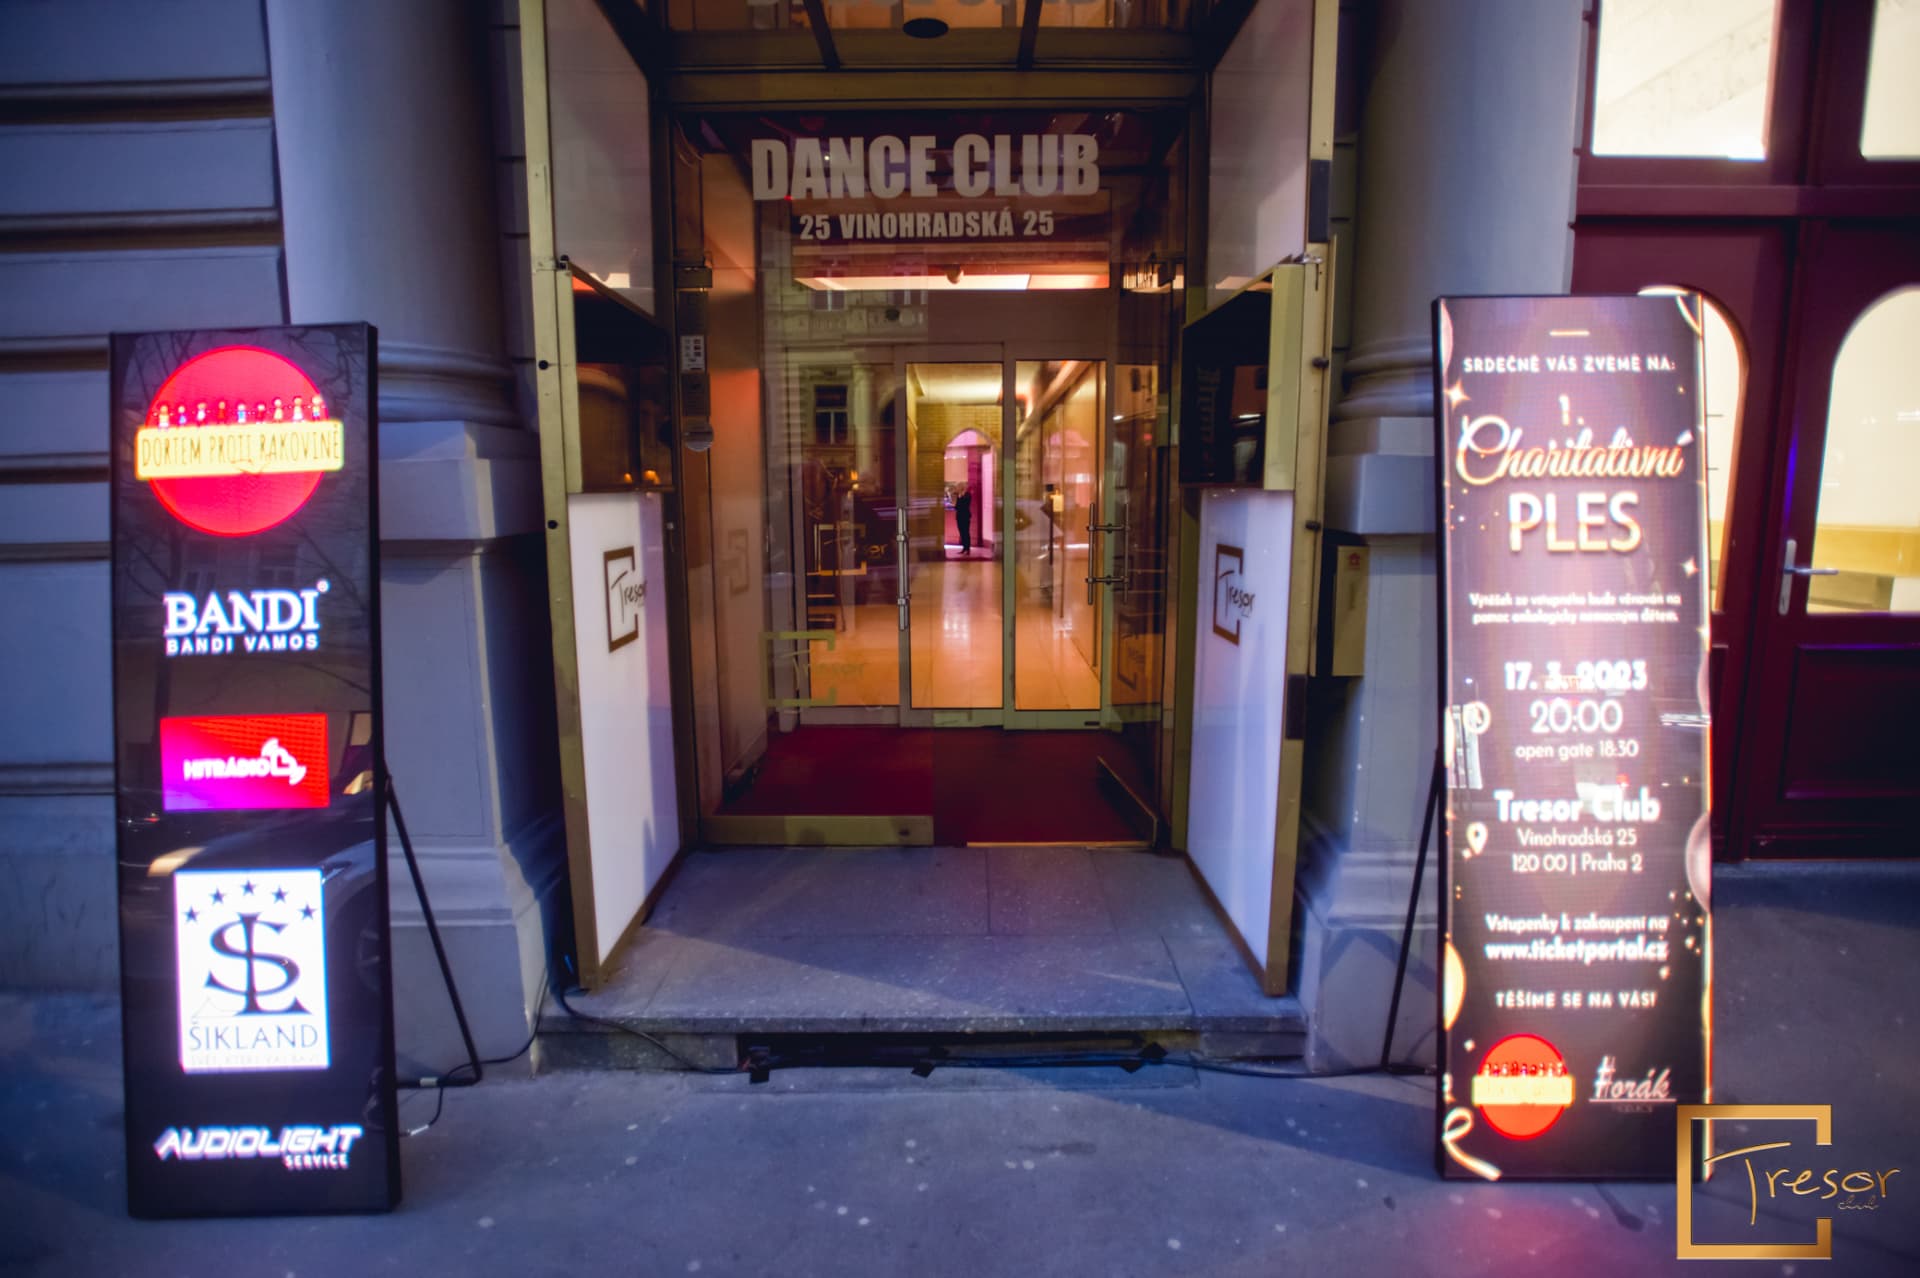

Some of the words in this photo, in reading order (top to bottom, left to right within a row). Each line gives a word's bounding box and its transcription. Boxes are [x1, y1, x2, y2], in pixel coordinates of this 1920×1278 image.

[751, 135, 937, 200] DANCE
[953, 133, 1100, 197] CLUB
[800, 214, 831, 240] 25
[840, 206, 1014, 239] VINOHRADSKÁ
[1023, 210, 1054, 236] 25
[1546, 354, 1578, 372] VÁS
[1584, 355, 1641, 372] ZVEME
[1647, 355, 1677, 371] NA:
[1559, 393, 1585, 427] 1.
[141, 438, 201, 467] DORTEM
[1455, 415, 1694, 486] Charitativní
[1508, 491, 1642, 553] PLES
[610, 570, 647, 624] Tresor
[1219, 570, 1255, 618] Tresor
[165, 636, 234, 656] BANDI
[244, 634, 320, 652] VAMOS
[1504, 661, 1538, 690] 17.
[1576, 659, 1648, 690] 2023
[1529, 700, 1623, 734] 20:00
[1515, 743, 1554, 761] open
[1558, 741, 1594, 762] gate
[1599, 739, 1639, 758] 18:30
[1493, 789, 1585, 823] Tresor
[1592, 787, 1661, 823] Club
[1516, 827, 1614, 847] Vinohradská
[1616, 827, 1637, 846] 25
[1512, 853, 1540, 873] 120
[1542, 853, 1568, 873] 00
[1581, 853, 1627, 873] Praha
[1630, 853, 1643, 872] 2
[1485, 912, 1557, 934] Vstupenky
[1560, 912, 1571, 931] k
[1573, 912, 1646, 934] zakoupení
[1648, 916, 1670, 931] na
[1484, 934, 1670, 966] www.ticketportal.cz
[1496, 989, 1556, 1009] TĚŠÍME
[1562, 991, 1582, 1008] SE
[1588, 991, 1613, 1008] NA
[1618, 989, 1658, 1007] VÁS!
[189, 1018, 319, 1051] ŠIKLAND
[153, 1125, 363, 1161] AUDIOLIGHT
[284, 1153, 349, 1171] SERVICE
